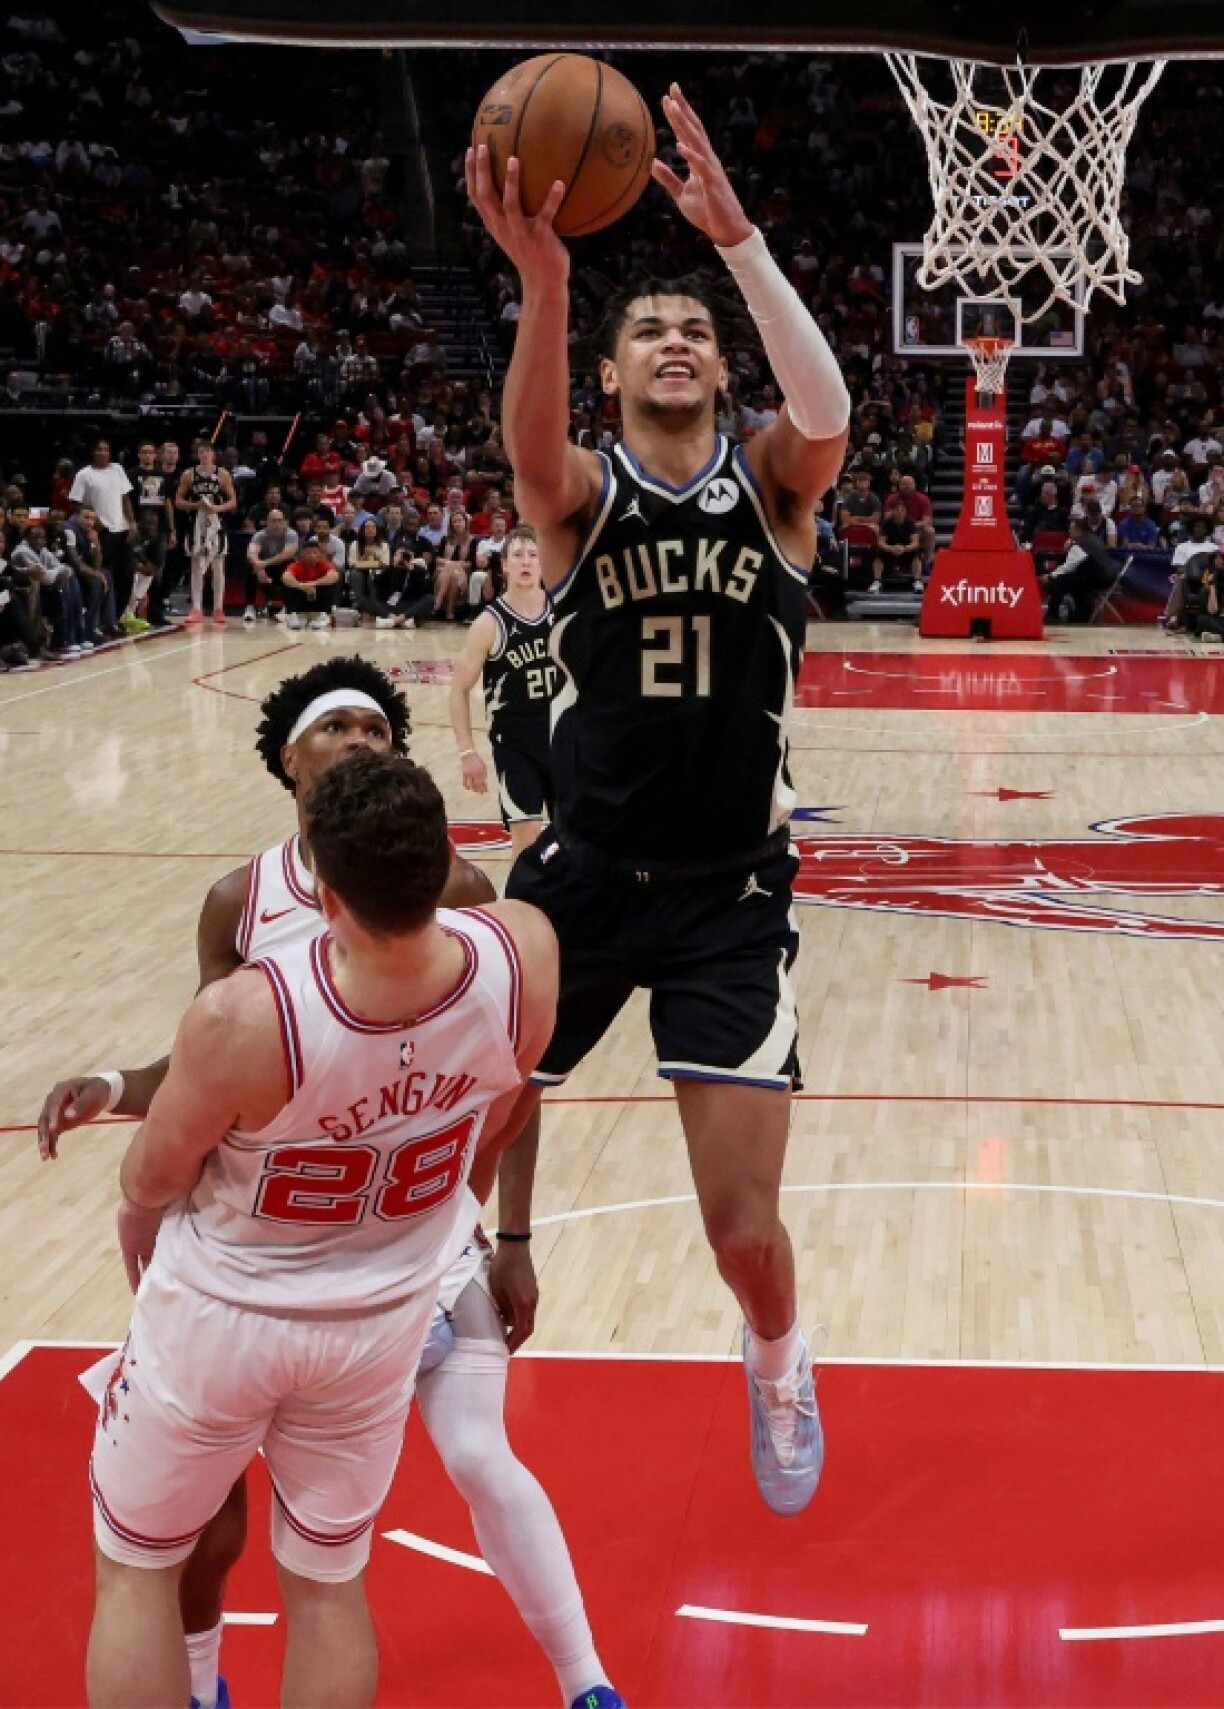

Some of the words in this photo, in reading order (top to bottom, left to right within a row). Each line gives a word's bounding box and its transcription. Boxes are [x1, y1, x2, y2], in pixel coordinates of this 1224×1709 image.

[596, 538, 764, 610] BUCKS
[941, 579, 1024, 608] xfinity
[506, 638, 550, 669] BUC
[641, 616, 711, 697] 21
[252, 1110, 479, 1226] 28
